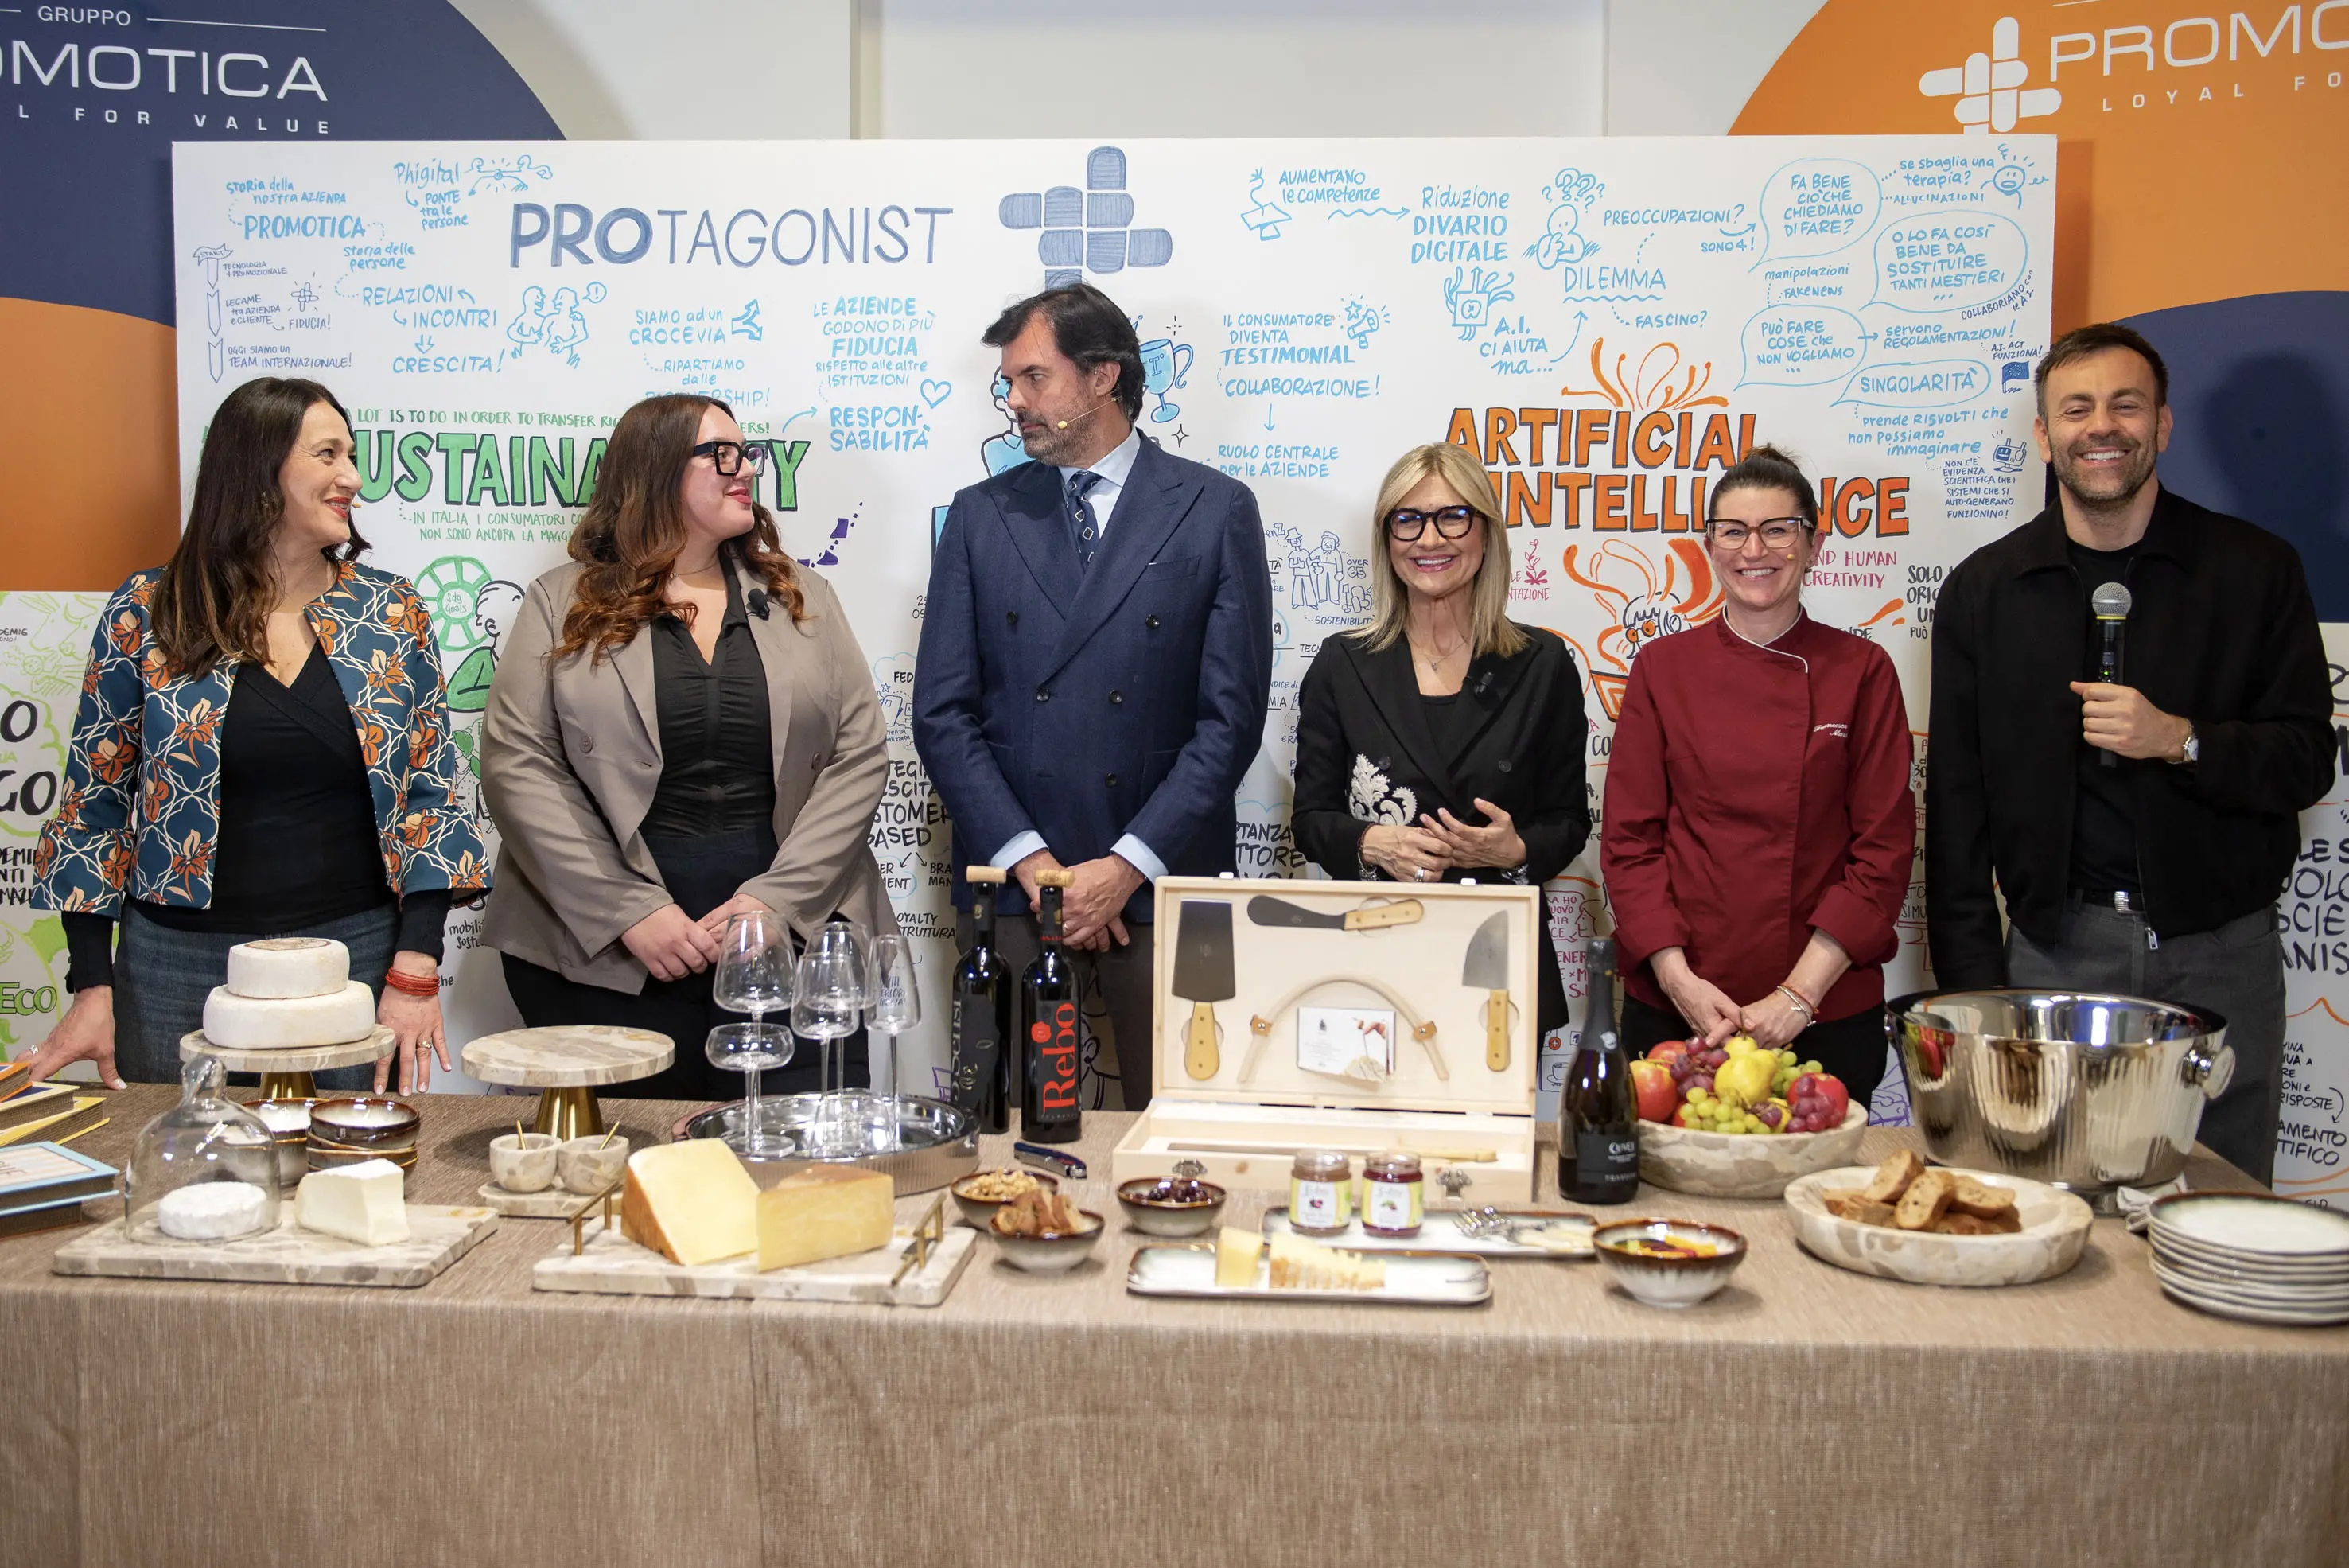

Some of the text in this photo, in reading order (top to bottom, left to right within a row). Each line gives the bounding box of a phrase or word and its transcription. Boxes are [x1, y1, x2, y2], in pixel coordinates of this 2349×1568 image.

[38, 6, 131, 26] GRUPPO
[2050, 1, 2349, 82] PROMO
[0, 40, 328, 102] MOTICA
[2102, 83, 2245, 111] LOYAL
[75, 107, 329, 134] FOR VALUE
[1900, 157, 1994, 172] se sbaglia una
[394, 158, 460, 189] Phigital
[1791, 173, 1851, 190] FA BENE
[1904, 171, 1971, 188] terapia?
[270, 176, 294, 191] della
[253, 191, 346, 204] nostra AZIENDA
[425, 189, 461, 204] PONTE
[1422, 185, 1510, 209] Riduzione
[1822, 190, 1852, 202] CHE
[1894, 193, 1984, 205] ALLUCINAZIONI
[420, 204, 452, 217] tra le
[1604, 204, 1744, 226] PREOCCUPAZIONI?
[1783, 204, 1863, 220] CHIEDIAMO
[244, 215, 366, 240] PROMOTICA
[422, 214, 469, 231] persone
[1414, 215, 1507, 236] DIVARIO
[1784, 219, 1854, 237] DI FARE?
[510, 203, 954, 268] PROTAGONIST
[1892, 228, 1949, 243] O LO FA
[344, 242, 415, 256] storia delle
[1411, 240, 1508, 264] DIGITALE
[1701, 241, 1734, 253] SONO
[1896, 242, 1966, 259] BENE DA
[223, 262, 267, 270] TECNOLOGIA
[350, 257, 406, 272] persone
[1765, 263, 1850, 282] manipolazioni
[1887, 254, 1987, 278] SOSTITUIRE
[1565, 267, 1666, 292] DILEMMA
[1891, 269, 2005, 291] TANTI MESTIERI
[226, 294, 261, 307] LEGAME
[363, 284, 453, 306] RELAZIONI
[1961, 284, 2024, 320] COLLABORIAMO
[245, 305, 281, 314] AZIENDA
[813, 295, 917, 317] LE AZIENDE
[289, 314, 331, 330] FIDUCIA!
[414, 309, 497, 328] INCONTRI
[636, 307, 723, 325] SIAMO ad un
[823, 310, 936, 336] GODONO PIÙ
[1223, 313, 1332, 327] IL CONSUMATORE
[1635, 310, 1708, 329] FASCINO?
[1494, 316, 1530, 337] A.I.
[1761, 318, 1824, 336] PUÒ FARE
[1884, 319, 2016, 349] REGOLAMENTAZIONI!
[1886, 324, 1942, 336] servono
[629, 326, 726, 345] CROCEVIA
[1230, 329, 1289, 344] DIVENTA
[1768, 335, 1834, 349] COSE che
[228, 345, 278, 355] OGGI SIAMO
[831, 336, 918, 358] FIDUCIA
[1480, 338, 1547, 357] CI AIUTA
[1993, 345, 2043, 360] FUNZIONA!
[229, 352, 352, 368] TEAM INTERNAZIONALE!
[1220, 346, 1355, 366] TESTIMONIAL
[1757, 348, 1855, 366] NON VOGLIAMO
[663, 358, 745, 372] RIPARTIAMO
[815, 359, 928, 373] RISPETTO alle altre
[682, 374, 716, 386] dalle
[827, 374, 909, 387] ISTITUZIONI
[1861, 367, 1978, 393] SINGOLARITÀ
[357, 408, 597, 427] LOT IS TO DO IN ORDER TO TRANSFER
[830, 405, 923, 428] RESPON-
[1863, 406, 2009, 428] prende RISVOLTI che
[830, 423, 931, 452] SABILITÀ
[1849, 430, 1945, 444] non possiamo
[1219, 445, 1339, 460] RUOLO CENTRALE
[1887, 441, 1981, 461] immaginare
[1219, 462, 1330, 478] per le AZIENDE
[1943, 466, 1985, 477] EVIDENZA
[1943, 477, 1995, 486] SCIENTIFICA
[1947, 487, 2010, 497] SISTEMI CHE SI
[1945, 497, 2015, 507] AUTO-GENERANO
[414, 512, 565, 526] IN ITALIA I CONSUMATORI
[1946, 509, 2009, 519] FUNZIONINO!
[420, 528, 442, 541] NON
[445, 528, 471, 539] SONO
[522, 531, 534, 542] LA
[1845, 551, 1897, 567] HUMAN
[1803, 570, 1885, 589] CREATIVITY
[1908, 564, 1943, 584] SOLO
[445, 604, 468, 614] Goals
[1910, 626, 1928, 640] PUÒ
[1042, 1002, 1075, 1114] Rebo
